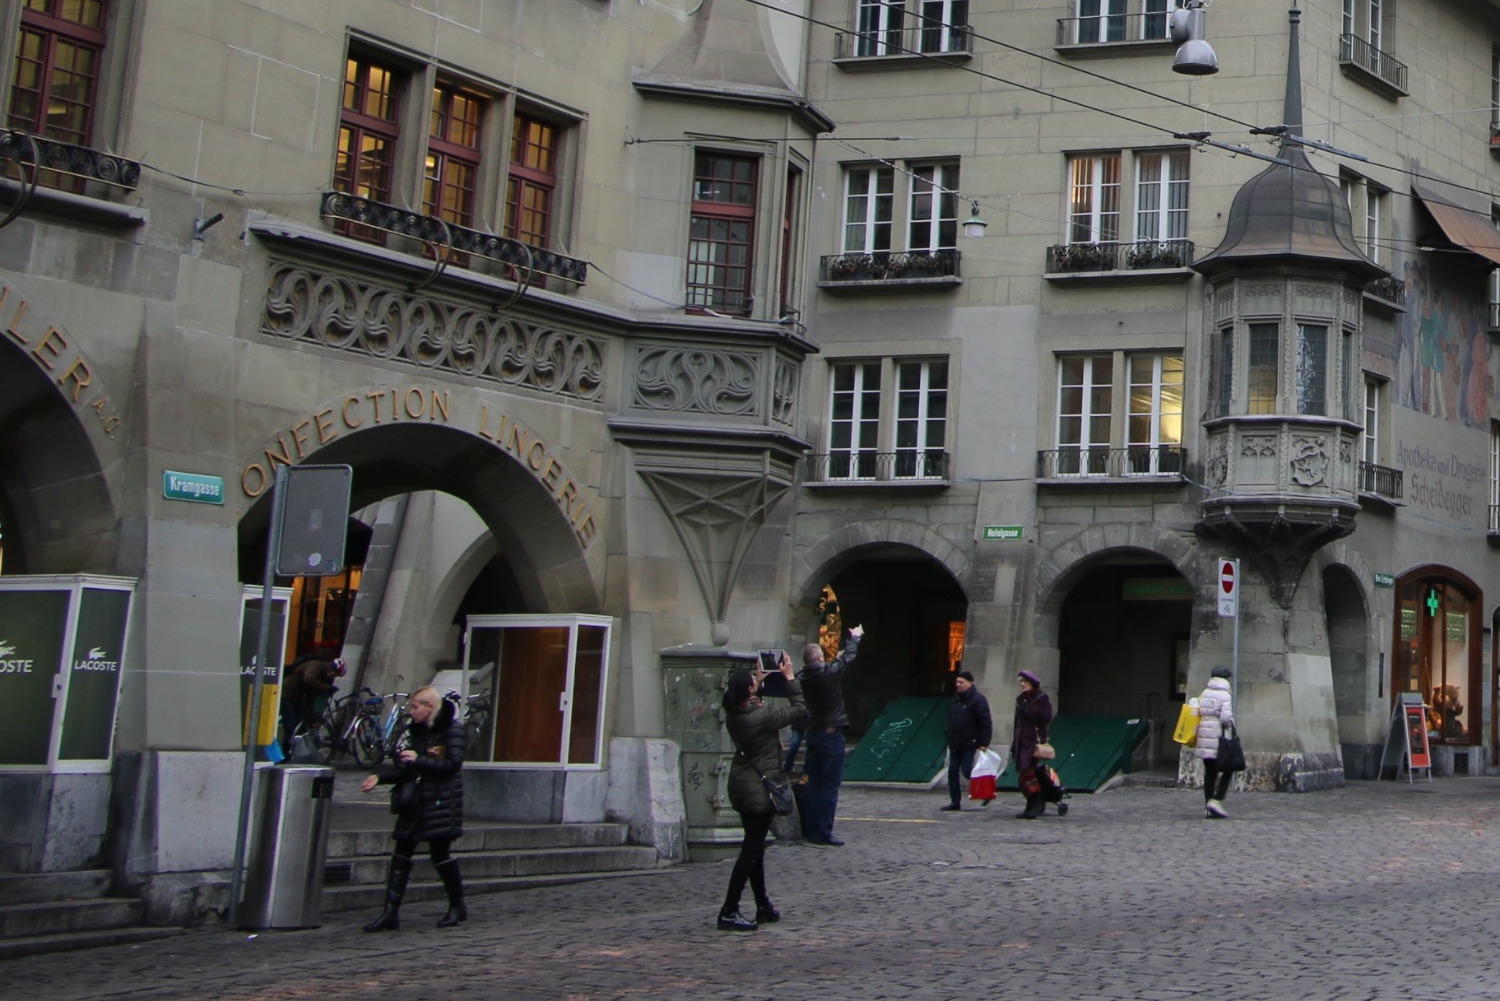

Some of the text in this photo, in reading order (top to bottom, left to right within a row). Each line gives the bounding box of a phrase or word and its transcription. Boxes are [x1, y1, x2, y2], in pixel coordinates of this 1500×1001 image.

[479, 406, 597, 549] LINGERIE
[1397, 441, 1437, 472] Apotheke
[1451, 454, 1486, 490] Drogerie
[170, 476, 220, 497] Kramgasse
[1410, 473, 1473, 518] Scheidegger
[74, 660, 117, 671] LACOSTE
[240, 666, 277, 676] LACSTE
